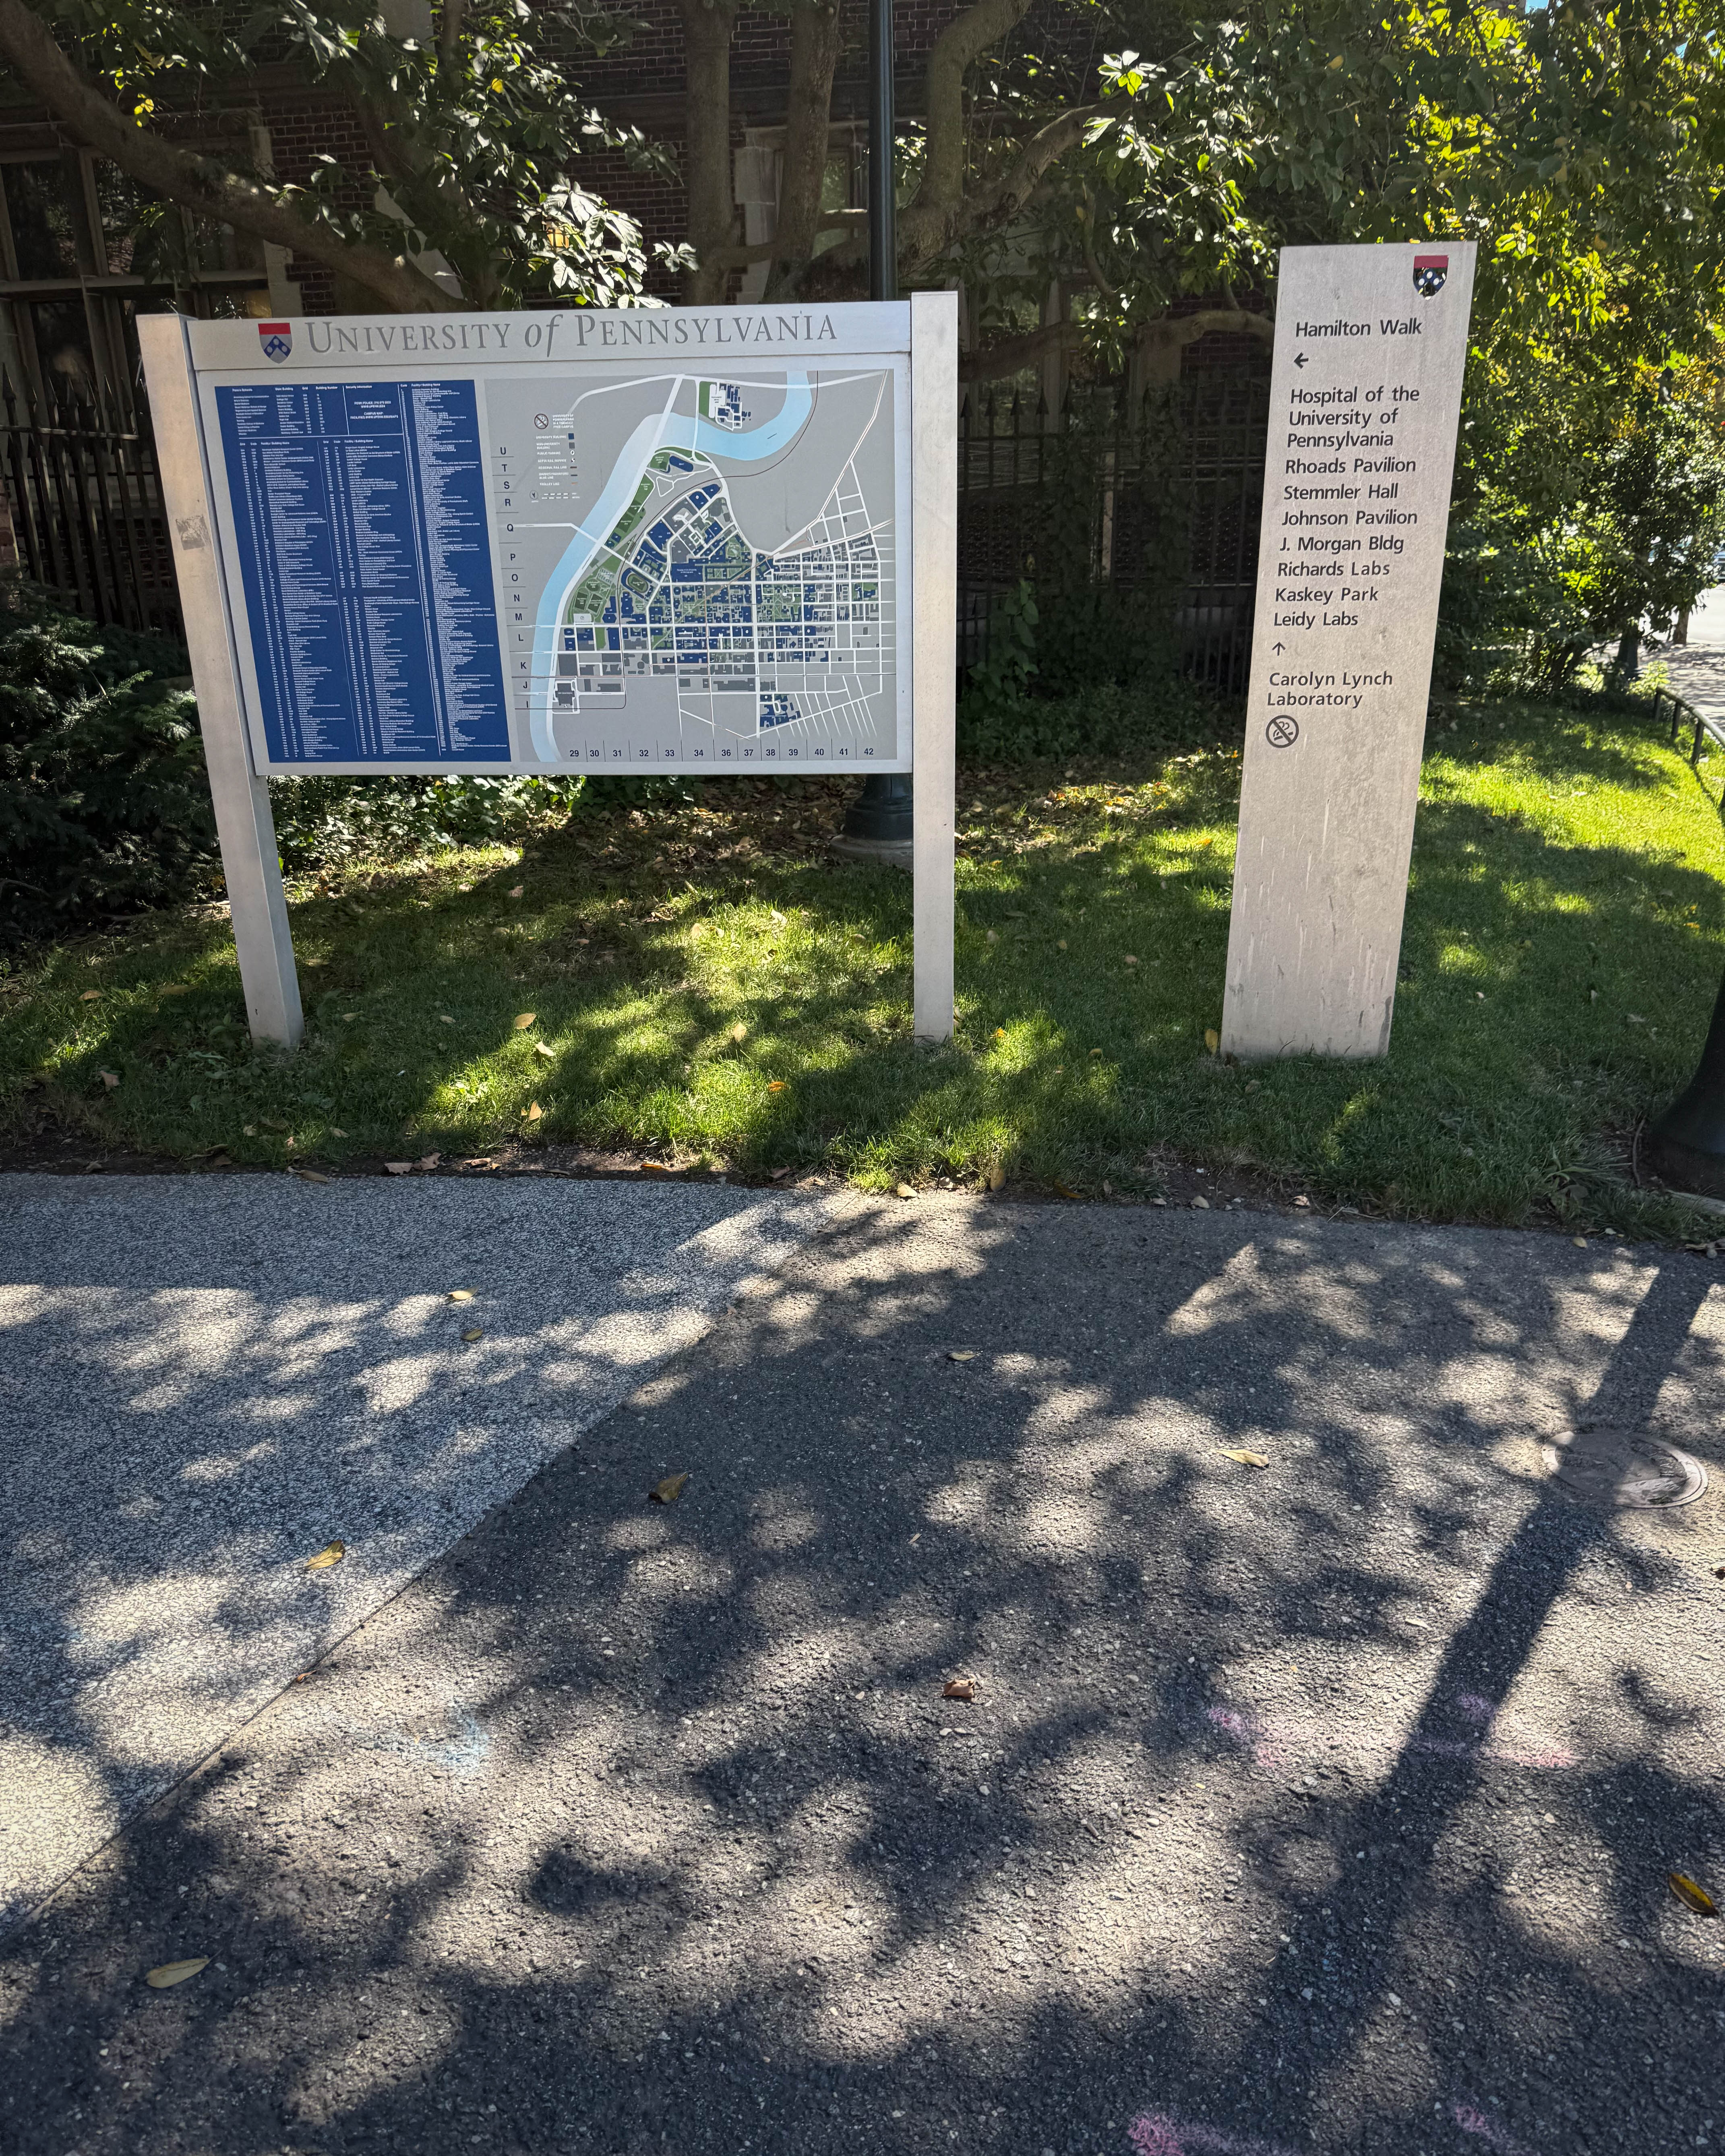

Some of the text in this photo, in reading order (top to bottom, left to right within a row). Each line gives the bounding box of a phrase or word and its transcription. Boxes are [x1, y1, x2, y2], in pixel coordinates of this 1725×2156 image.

[305, 314, 837, 358] UNIVERSITY of PENNSYLVANIA
[1296, 318, 1422, 337] Hamilton Walk
[1291, 385, 1419, 407] Hospital of the
[1290, 407, 1398, 429] University of
[1288, 431, 1393, 451] Pennsylvania
[1286, 457, 1415, 473] Rhoads Pavilion
[1284, 483, 1398, 500] Stemmler Hall
[1282, 509, 1417, 525] Johnson Pavilion
[1280, 535, 1404, 554] J. Morgan Bldg
[1278, 561, 1390, 576] Richards Labs
[1276, 587, 1378, 605] Kaskey Park
[1274, 611, 1358, 630] Leidy Labs
[1270, 671, 1392, 689] Carolyn Lynch
[1268, 692, 1363, 709] Laboratory
